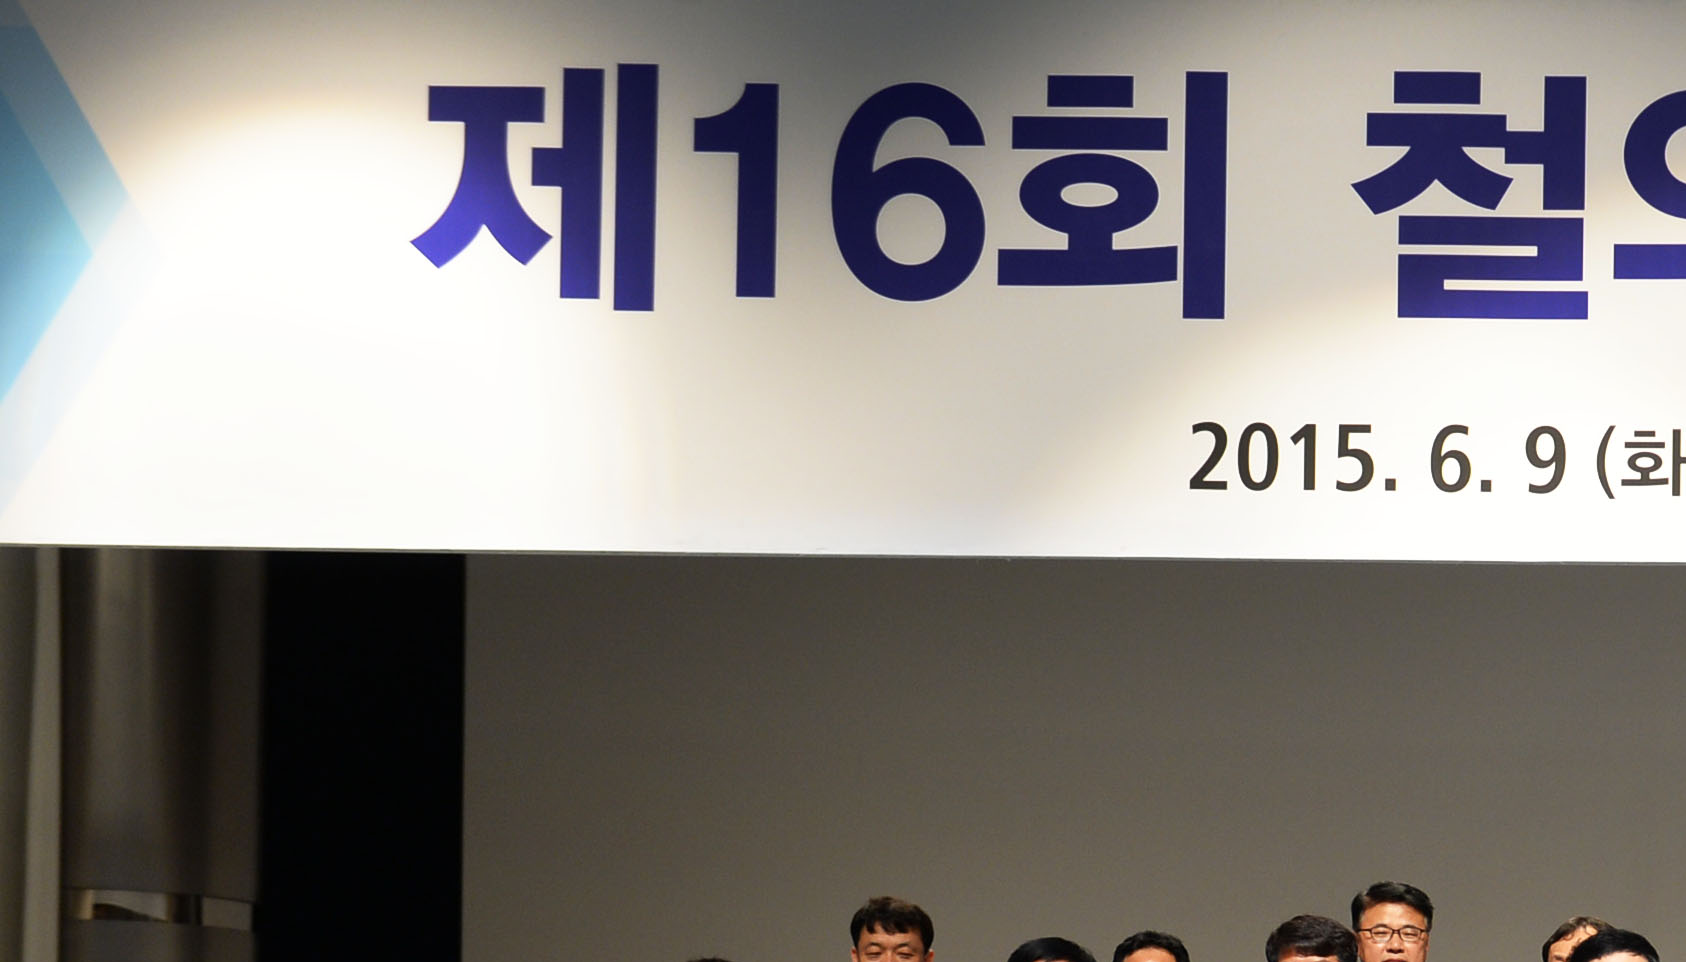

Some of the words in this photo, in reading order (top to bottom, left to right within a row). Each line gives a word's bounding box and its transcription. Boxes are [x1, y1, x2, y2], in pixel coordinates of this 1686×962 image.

[411, 63, 1228, 319] 제16회
[1189, 421, 1396, 492] 2015.
[1430, 424, 1493, 493] 6.
[1525, 425, 1566, 494] 9
